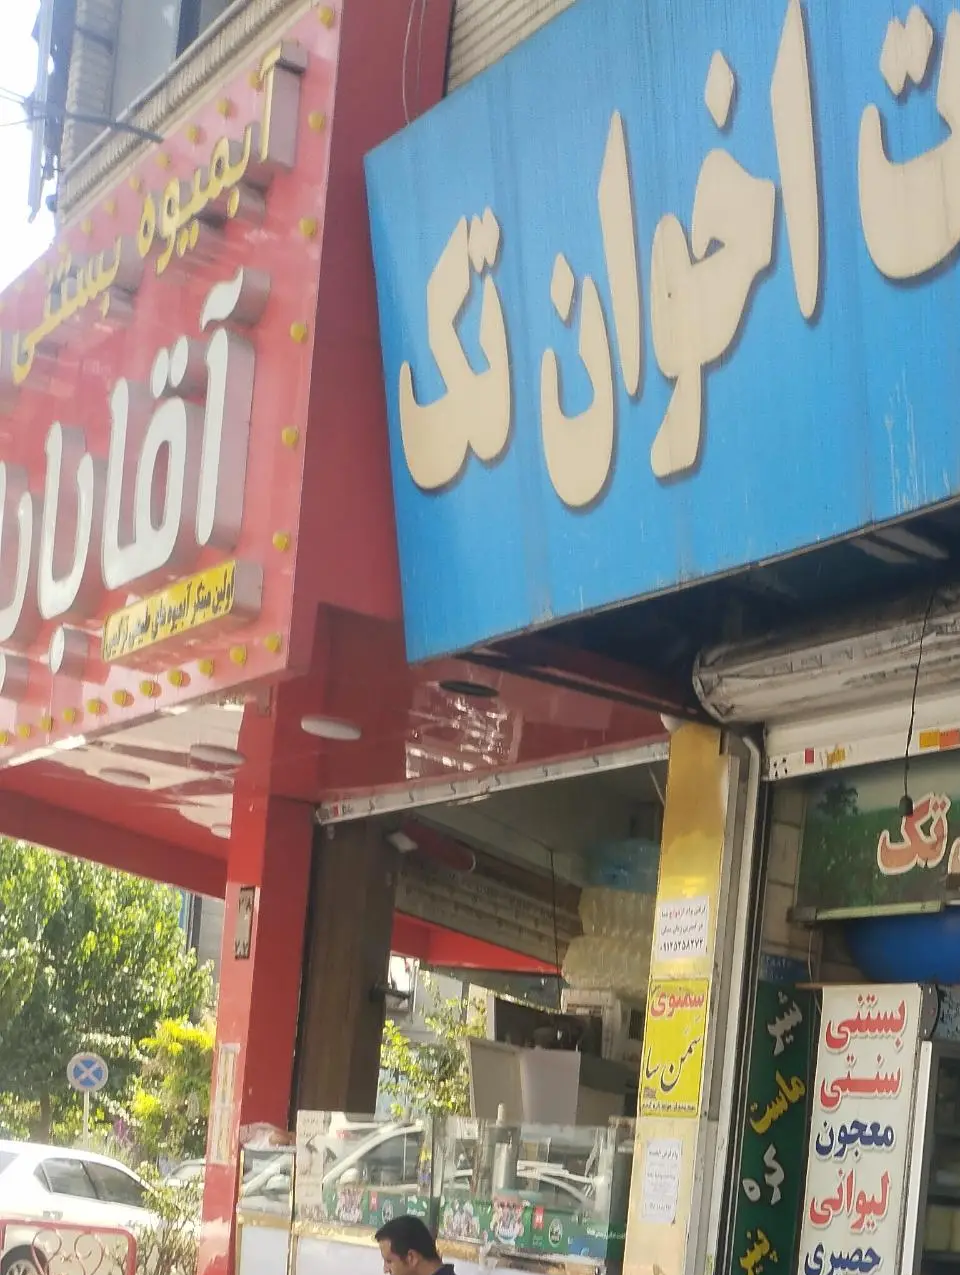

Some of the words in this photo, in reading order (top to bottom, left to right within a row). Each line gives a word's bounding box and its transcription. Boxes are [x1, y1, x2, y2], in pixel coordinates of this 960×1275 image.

[136, 46, 282, 276] آبمیوه
[540, 0, 822, 509] اخوان
[12, 234, 122, 386] بستنی
[398, 205, 512, 493] تک
[876, 790, 952, 876] تک
[767, 990, 803, 1056] شیر
[825, 994, 907, 1051] بستنی
[748, 1069, 806, 1135] ماست
[820, 1053, 902, 1110] سنتی
[815, 1118, 896, 1160] معجون
[742, 1143, 785, 1206] کره
[809, 1167, 891, 1232] لیوانی
